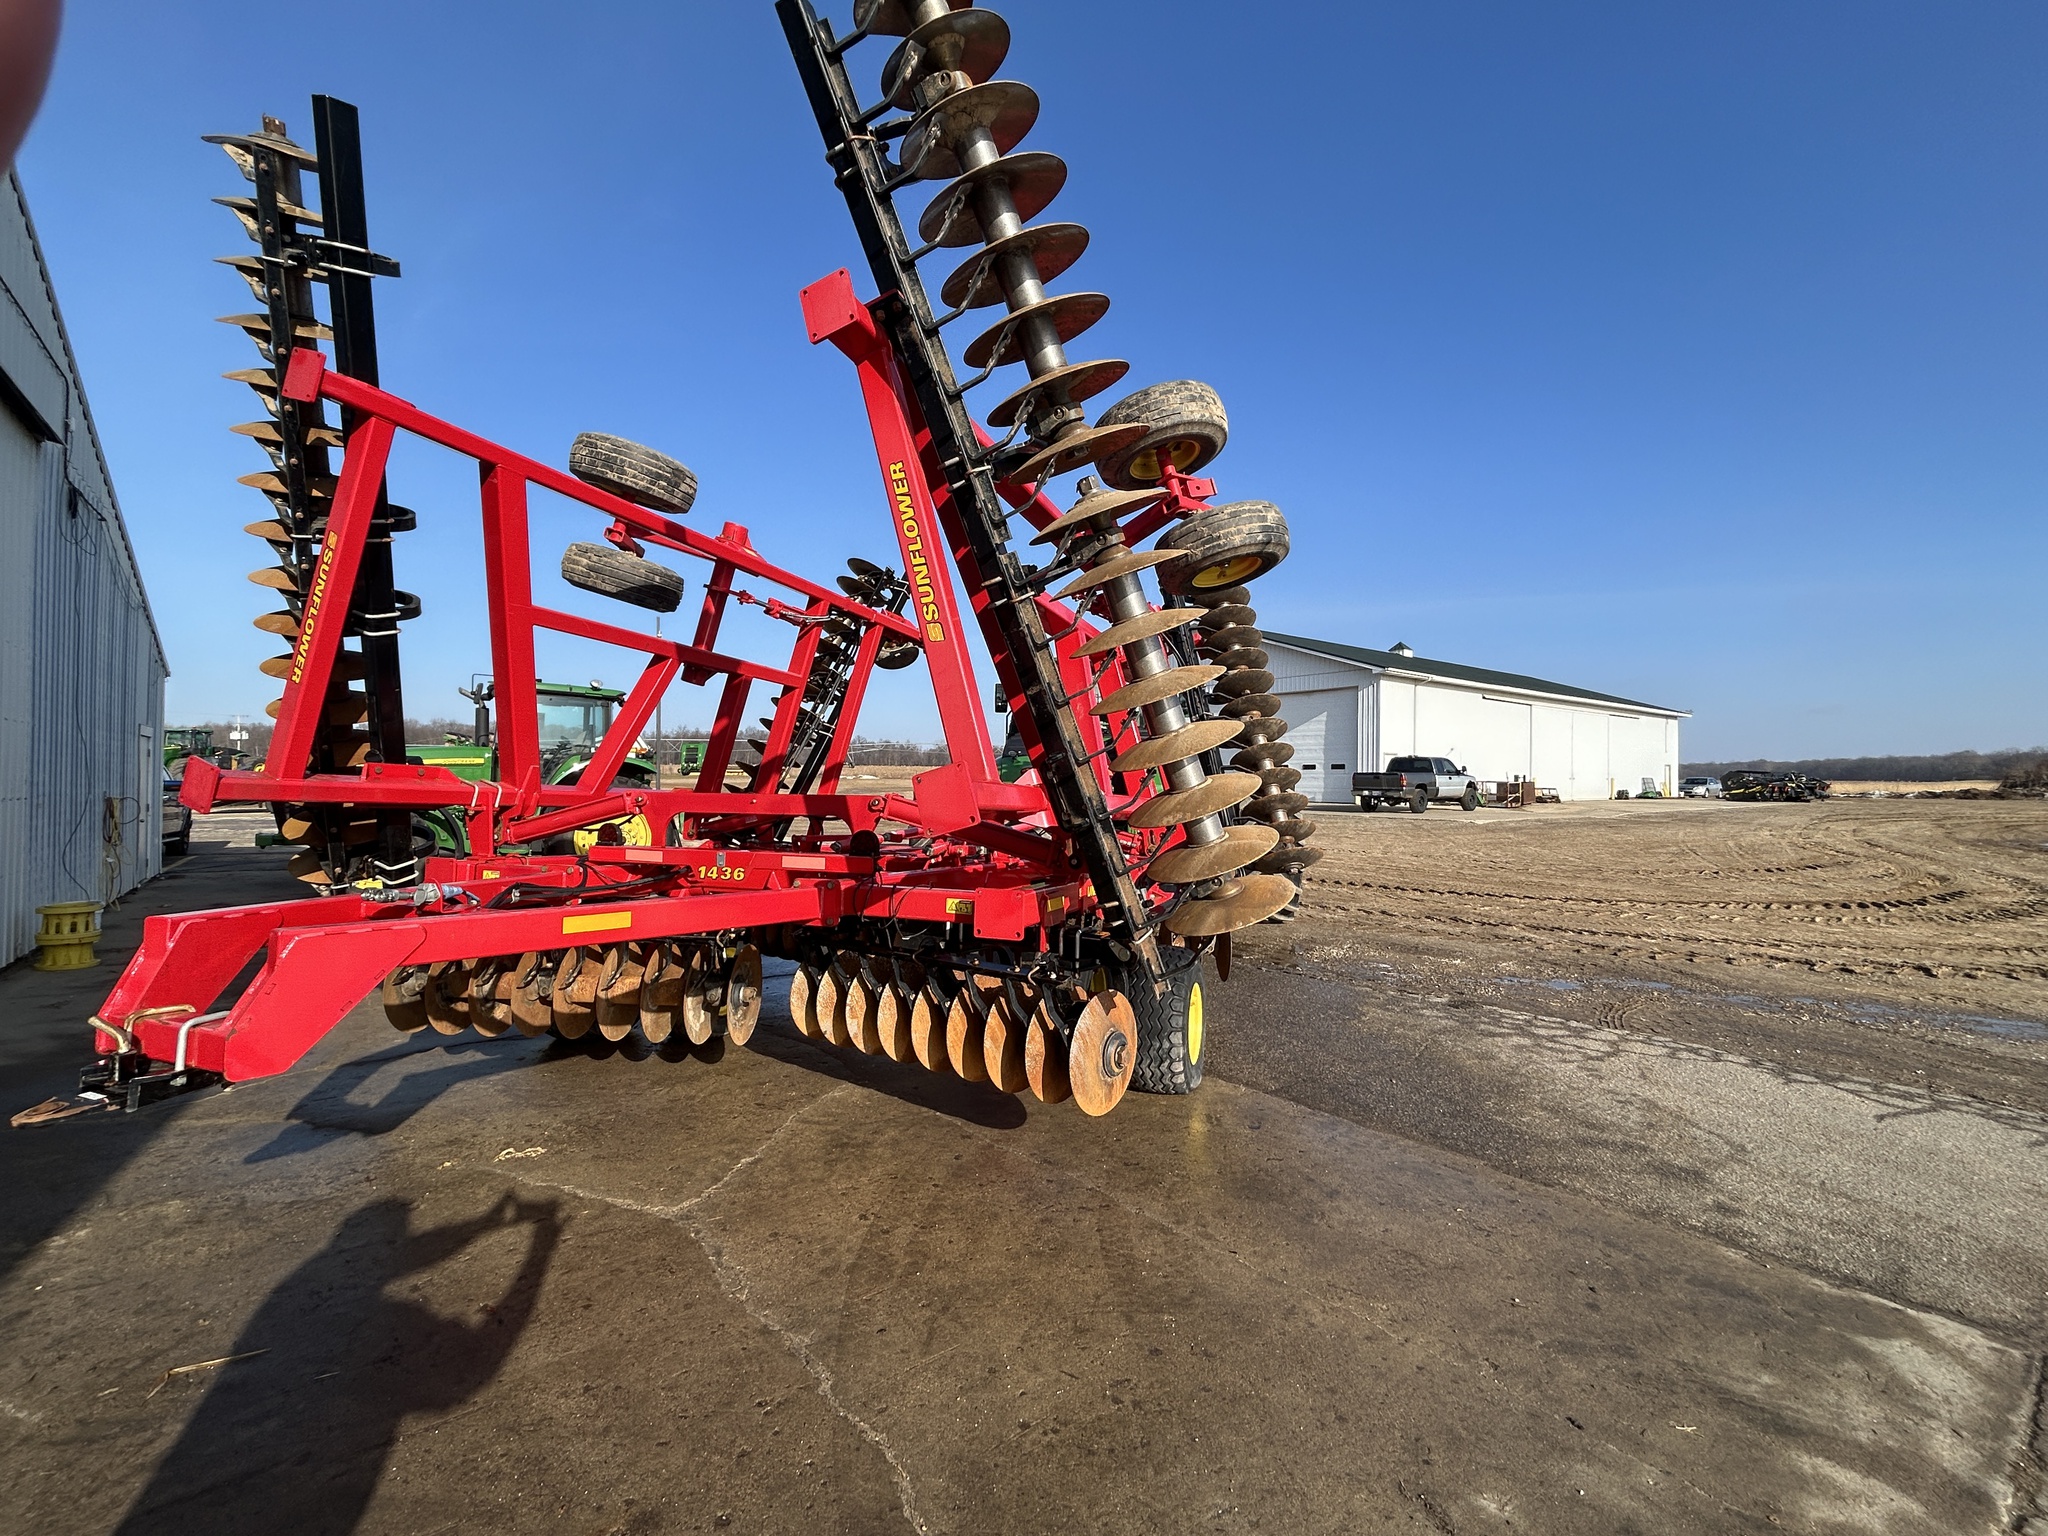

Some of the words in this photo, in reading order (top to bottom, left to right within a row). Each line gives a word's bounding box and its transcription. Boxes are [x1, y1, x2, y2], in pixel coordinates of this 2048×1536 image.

[889, 460, 940, 622] SUNFLOWER
[291, 549, 334, 684] SUNFLOWER
[698, 865, 745, 881] 1436
